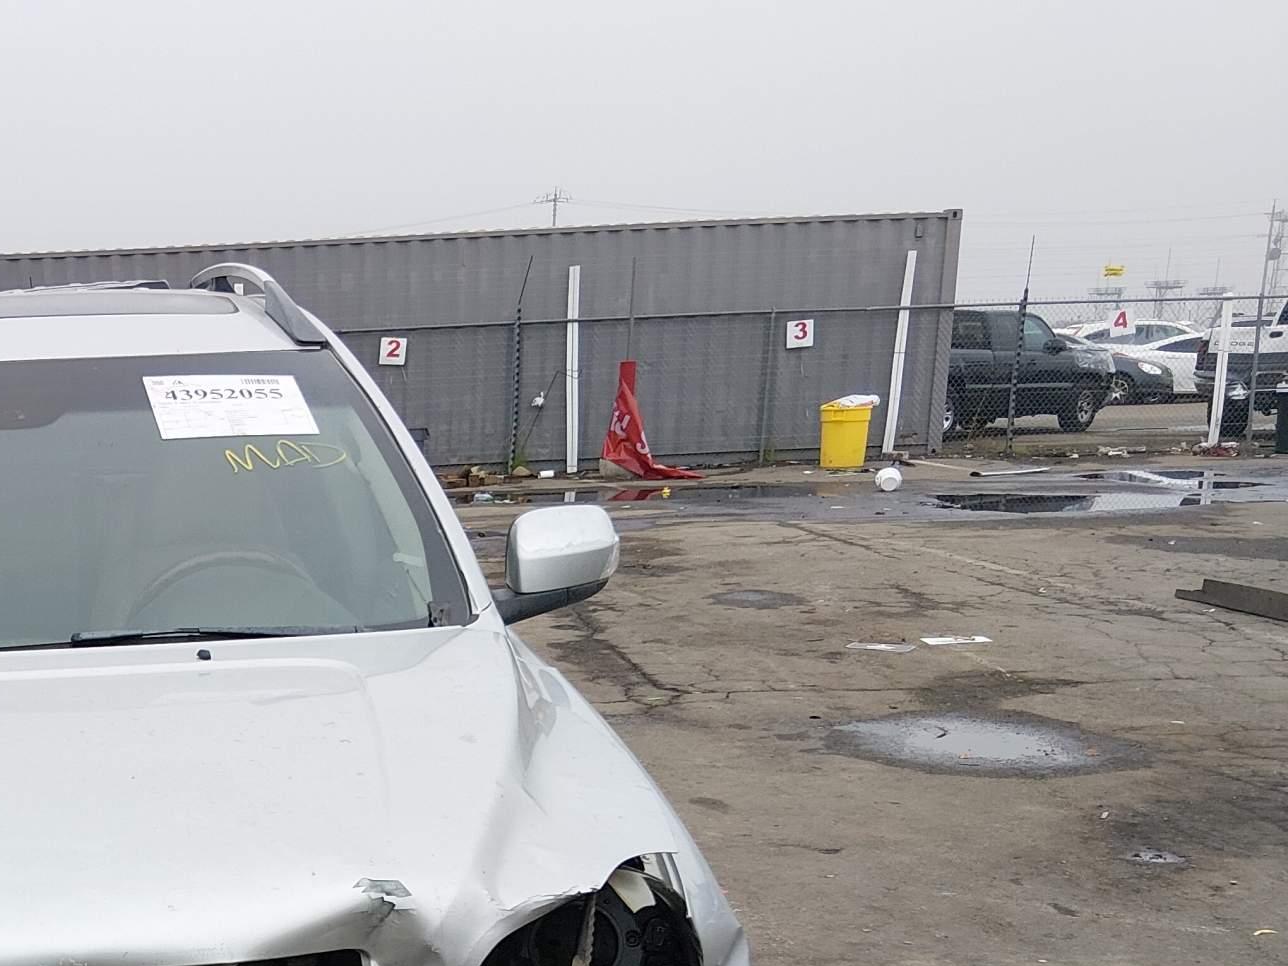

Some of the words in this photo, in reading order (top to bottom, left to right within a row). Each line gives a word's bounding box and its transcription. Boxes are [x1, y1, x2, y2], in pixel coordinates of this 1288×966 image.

[1114, 311, 1128, 329] 4
[794, 321, 808, 340] 3
[386, 340, 401, 358] 2
[165, 388, 284, 401] 43952055
[224, 439, 348, 473] MAD
